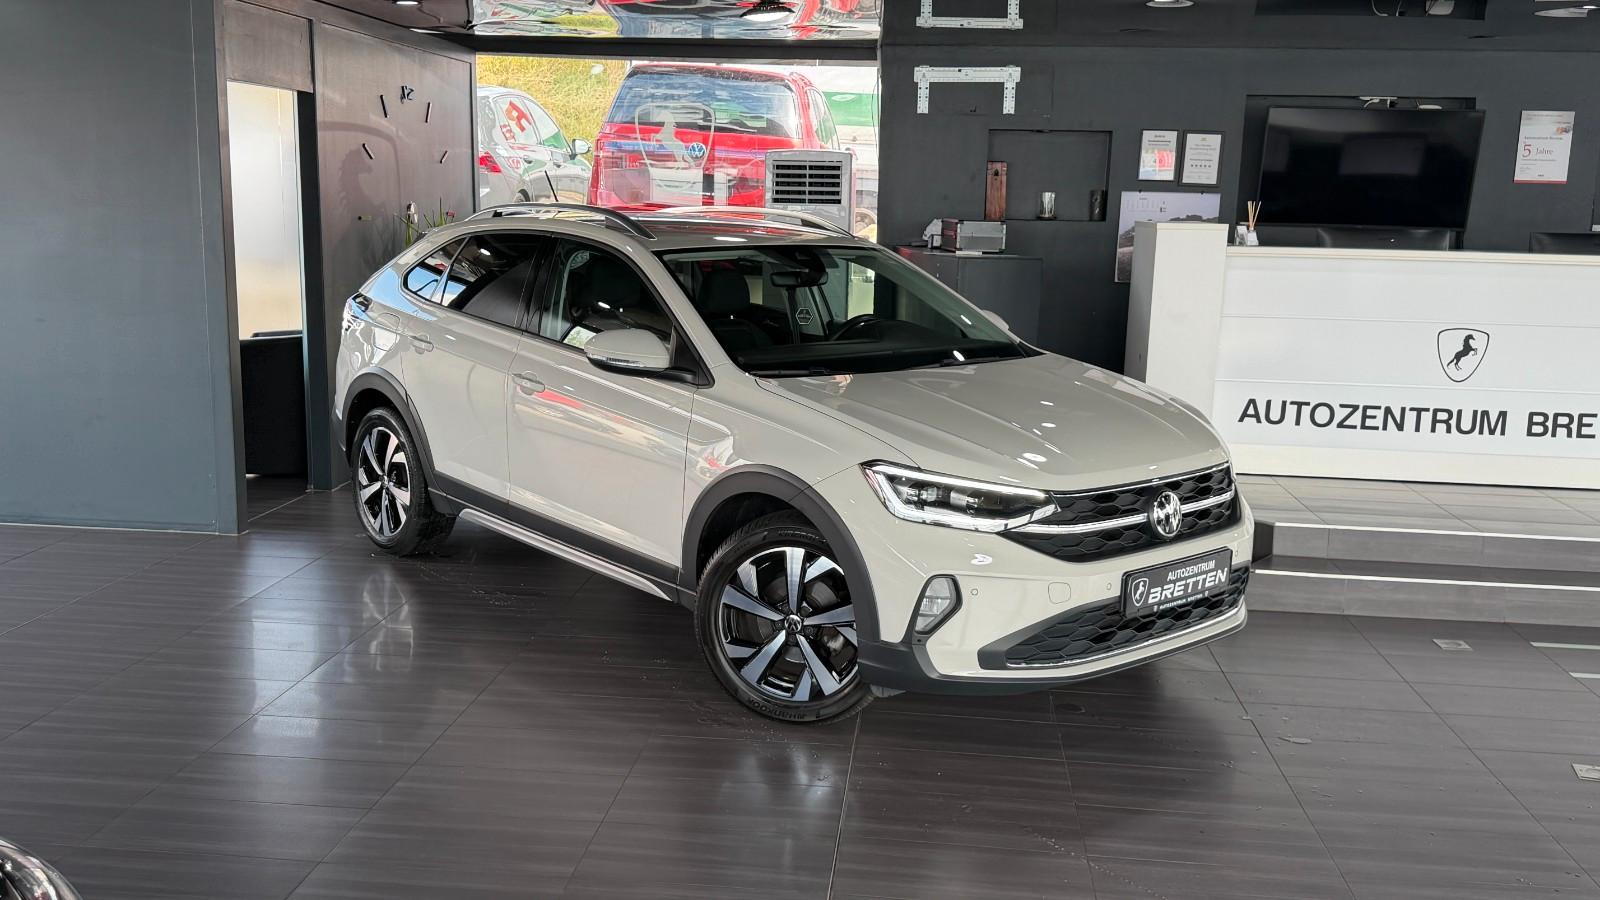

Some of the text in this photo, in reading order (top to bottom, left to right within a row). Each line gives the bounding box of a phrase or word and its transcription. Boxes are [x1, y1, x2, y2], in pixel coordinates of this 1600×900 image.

[1522, 144, 1532, 158] 5
[1238, 398, 1597, 439] AUTOZENTRUM BRE
[1167, 560, 1216, 581] AUTOZENTRUM
[1148, 568, 1228, 604] BRETTEN
